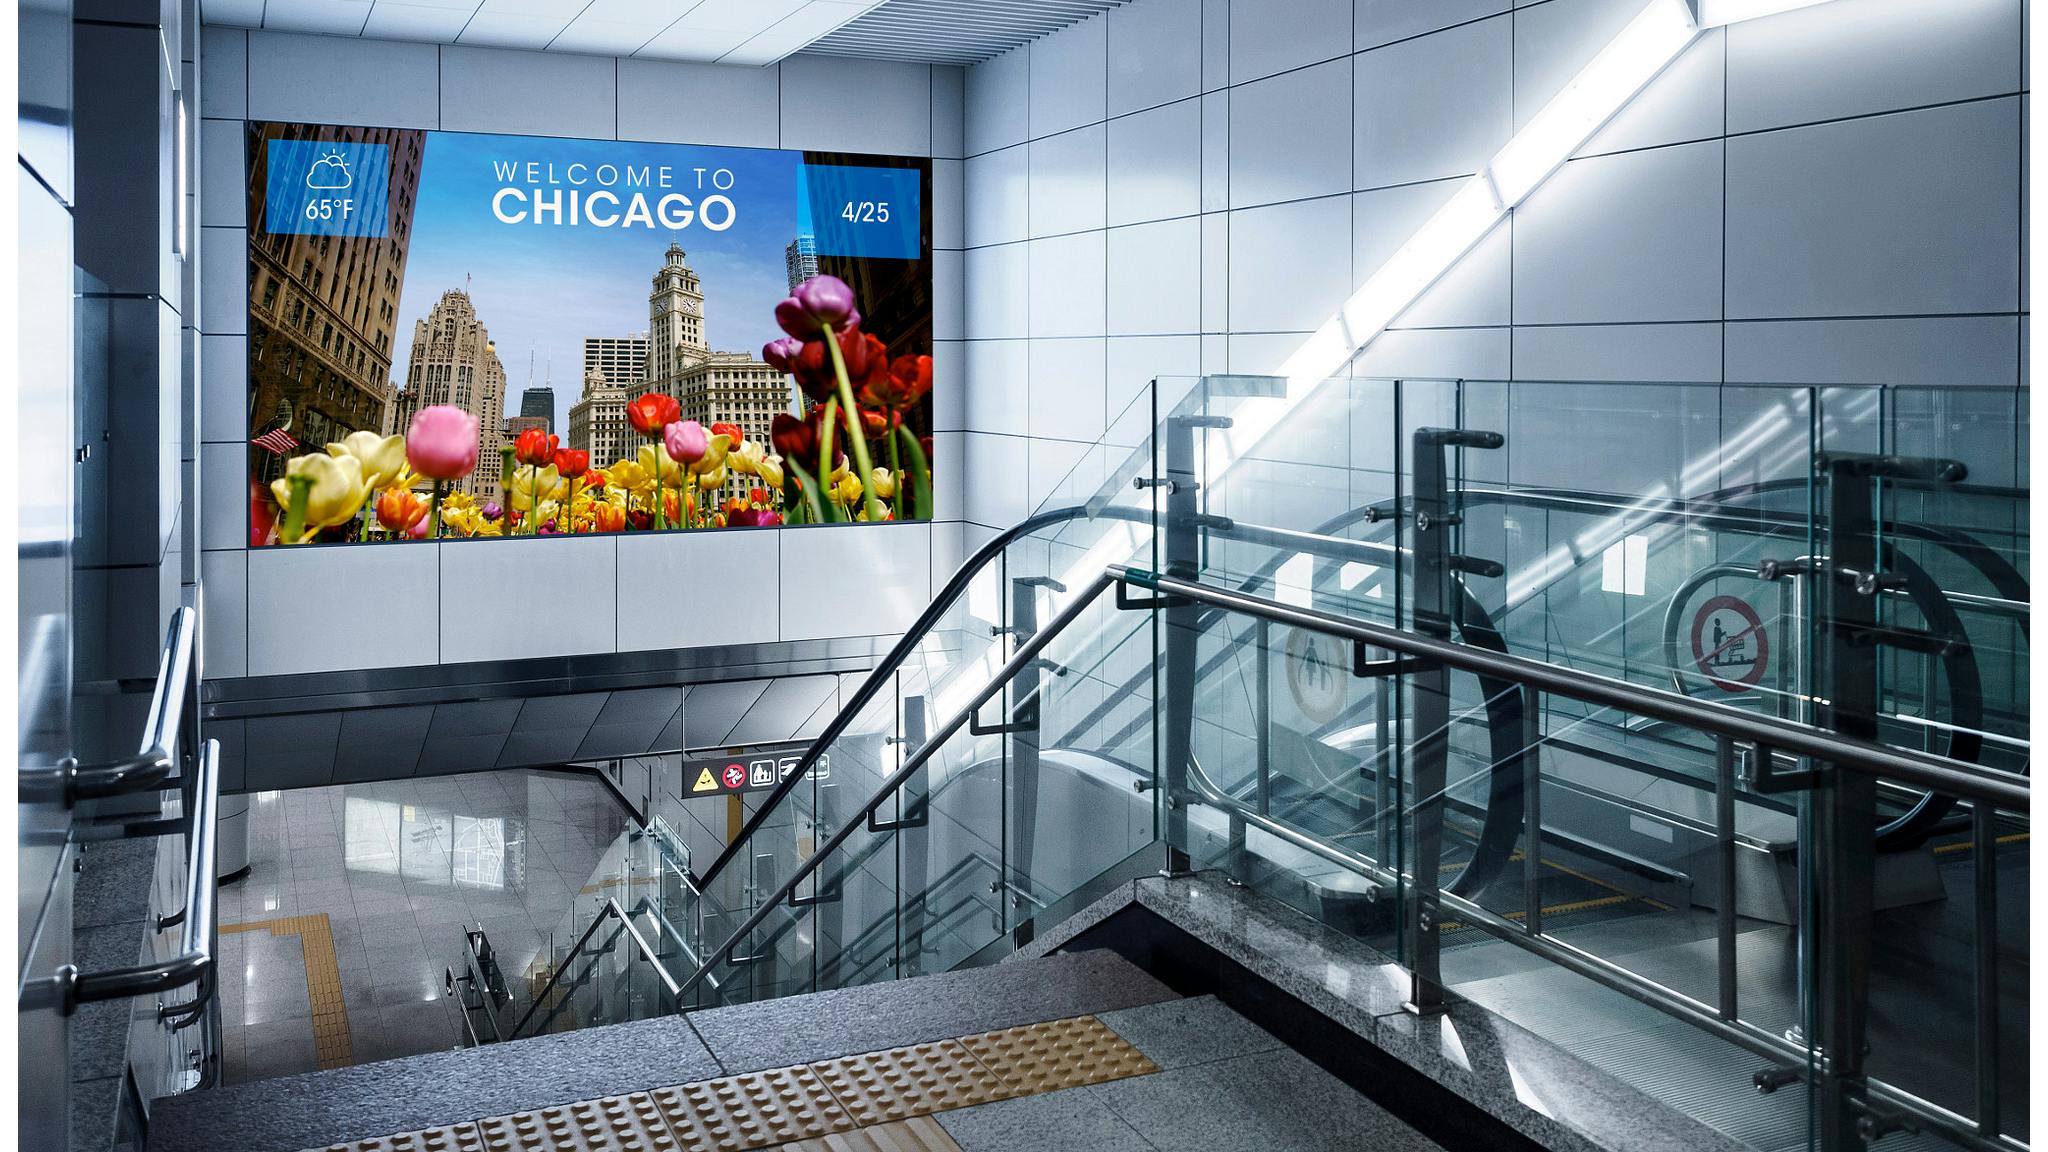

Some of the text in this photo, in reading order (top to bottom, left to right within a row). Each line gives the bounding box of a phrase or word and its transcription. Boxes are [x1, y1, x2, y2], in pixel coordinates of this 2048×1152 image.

[493, 161, 734, 190] WELCOME TO
[305, 199, 353, 220] 65°F
[492, 187, 736, 232] CHICAGO
[842, 201, 889, 223] 4/25
